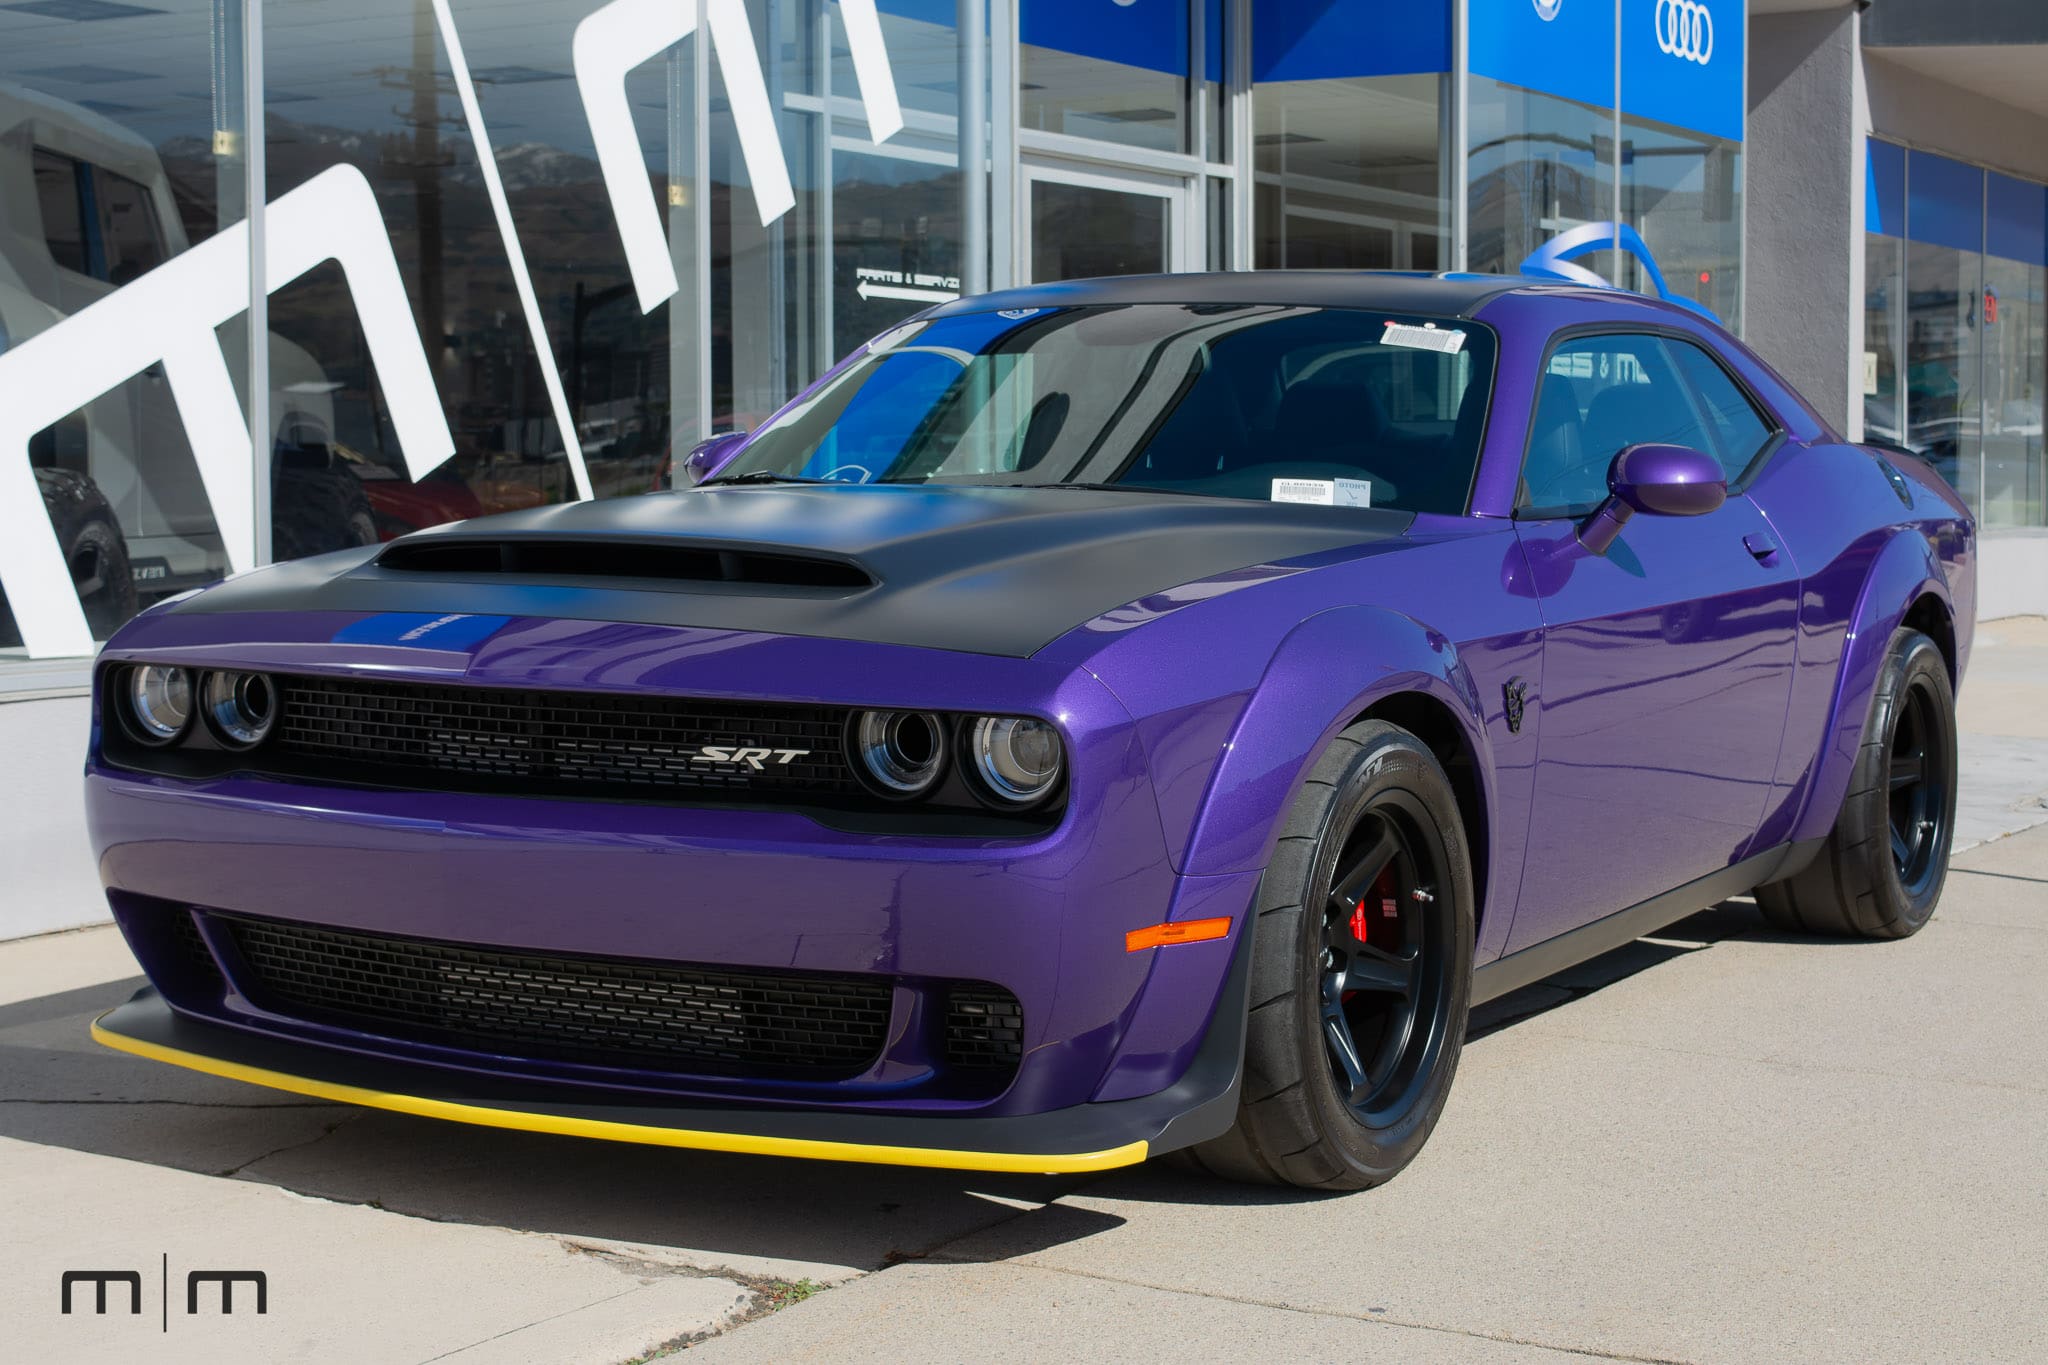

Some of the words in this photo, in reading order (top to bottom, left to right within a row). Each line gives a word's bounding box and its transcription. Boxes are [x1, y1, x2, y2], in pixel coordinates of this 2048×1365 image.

[856, 267, 902, 283] PARTS
[905, 272, 912, 284] &
[692, 746, 811, 770] SRT
